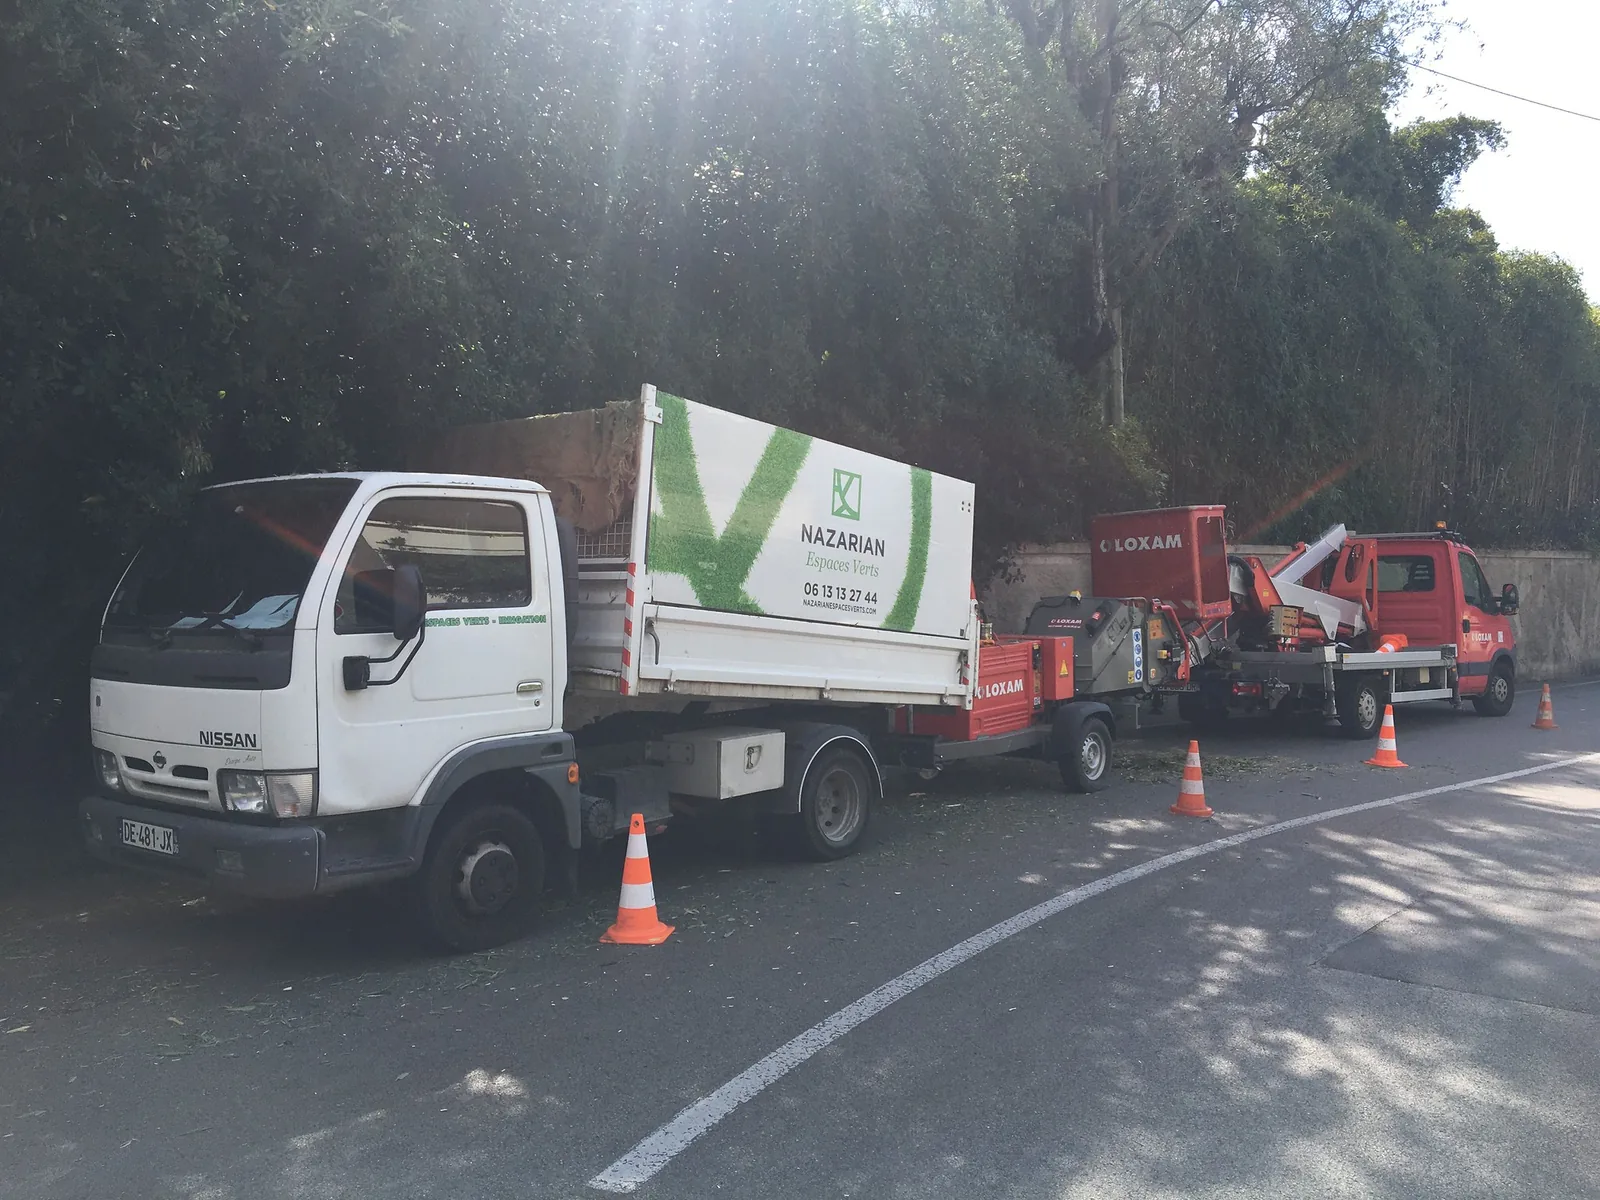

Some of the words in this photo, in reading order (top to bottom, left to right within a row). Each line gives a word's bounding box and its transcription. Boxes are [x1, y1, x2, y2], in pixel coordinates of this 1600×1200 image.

[801, 523, 885, 557] NAZARIAN
[1114, 534, 1182, 552] LOXAM
[806, 551, 850, 572] Espaces
[852, 559, 879, 577] Verts
[804, 582, 819, 597] 06
[822, 585, 833, 599] 13
[836, 587, 847, 601] 13
[849, 589, 862, 603] 27
[864, 591, 877, 605] 44
[803, 599, 877, 615] NAZARIANESPACESVERTS.COM
[463, 616, 490, 626] VERTS
[498, 615, 547, 625] IRRIGATION
[986, 679, 1023, 698] LOXAM
[200, 731, 257, 748] NISSAN
